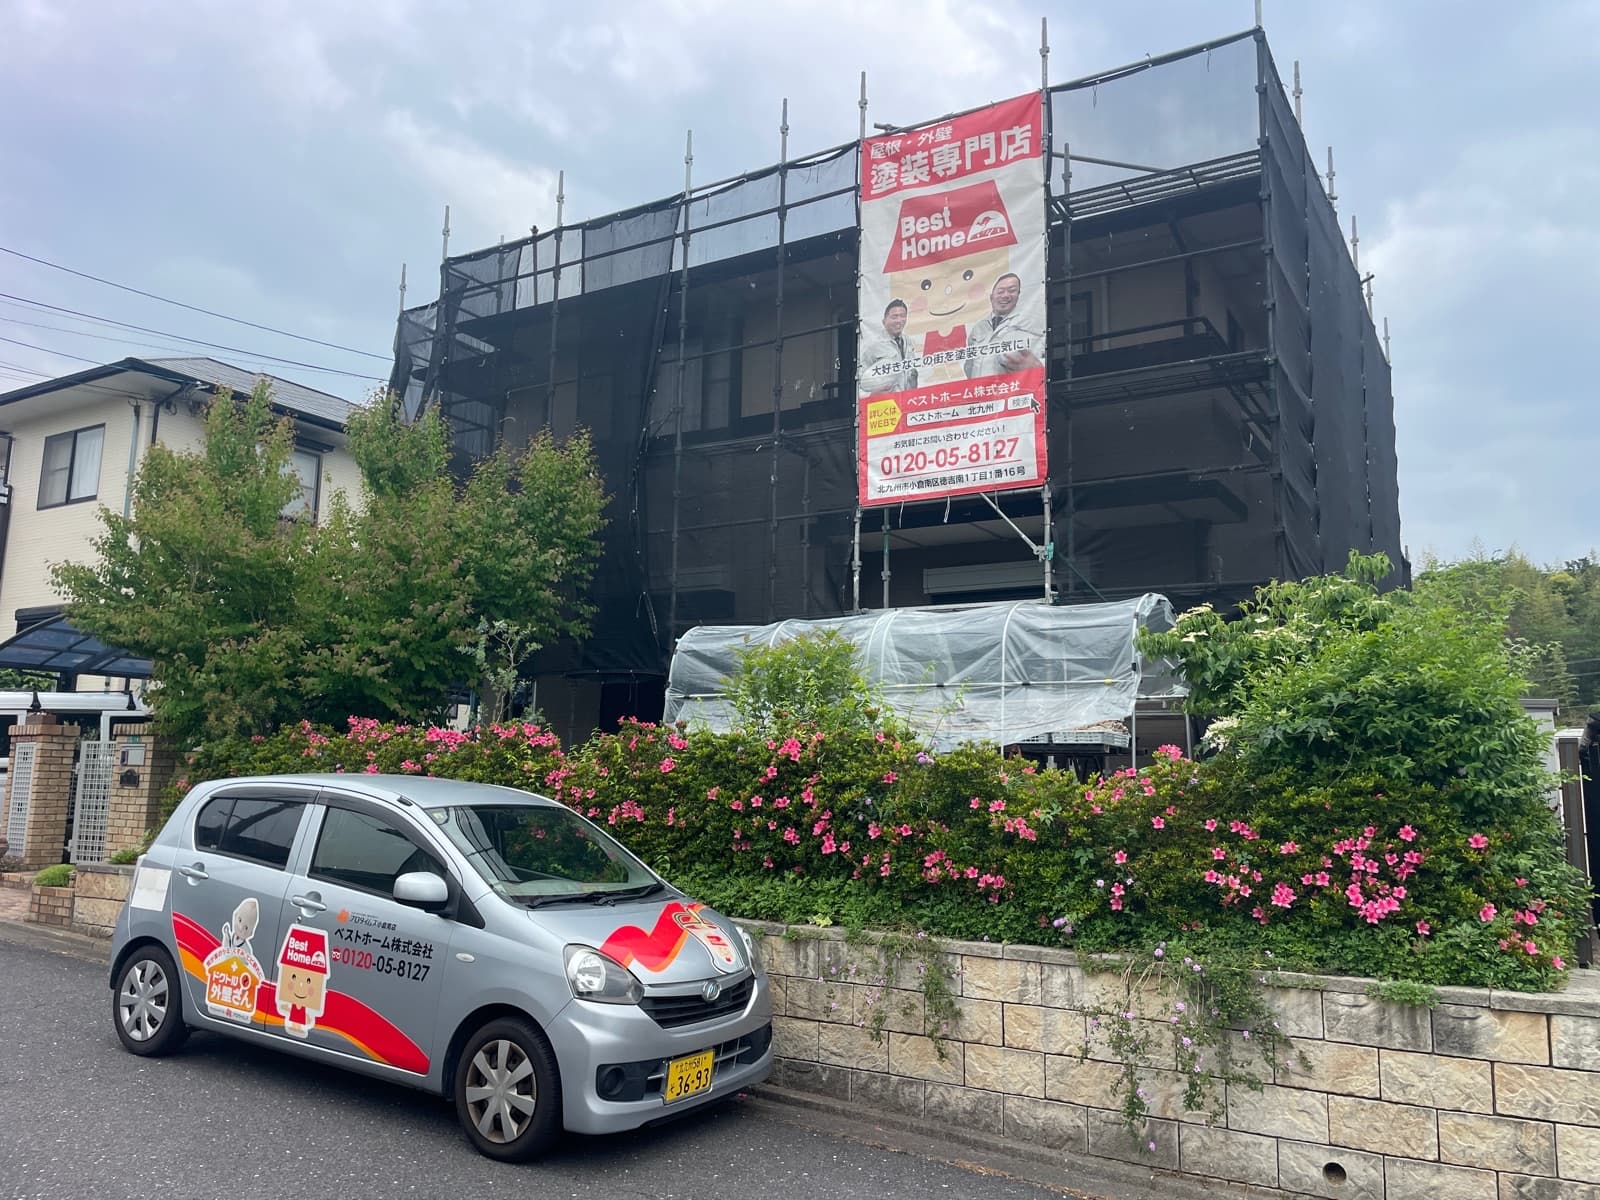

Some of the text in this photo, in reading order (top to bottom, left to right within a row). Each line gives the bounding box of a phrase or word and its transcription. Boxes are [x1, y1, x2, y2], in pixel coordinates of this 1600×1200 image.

[870, 125, 953, 160] 屋根・外壁
[870, 124, 1032, 195] 塗装専門店
[901, 206, 952, 239] Best
[901, 231, 967, 261] Home
[906, 380, 1020, 407] ベストホーム株式会社
[869, 406, 897, 420] 詳しくは
[869, 417, 897, 430] WEBで
[909, 402, 995, 424] ベストホーム 北九州
[880, 437, 1020, 476] 0120-05-8127
[286, 948, 311, 964] Home
[287, 936, 308, 951] Best
[334, 927, 434, 960] ベストホーム株式会社
[212, 971, 239, 985] ドクトル
[342, 947, 431, 982] 0120-05-8127
